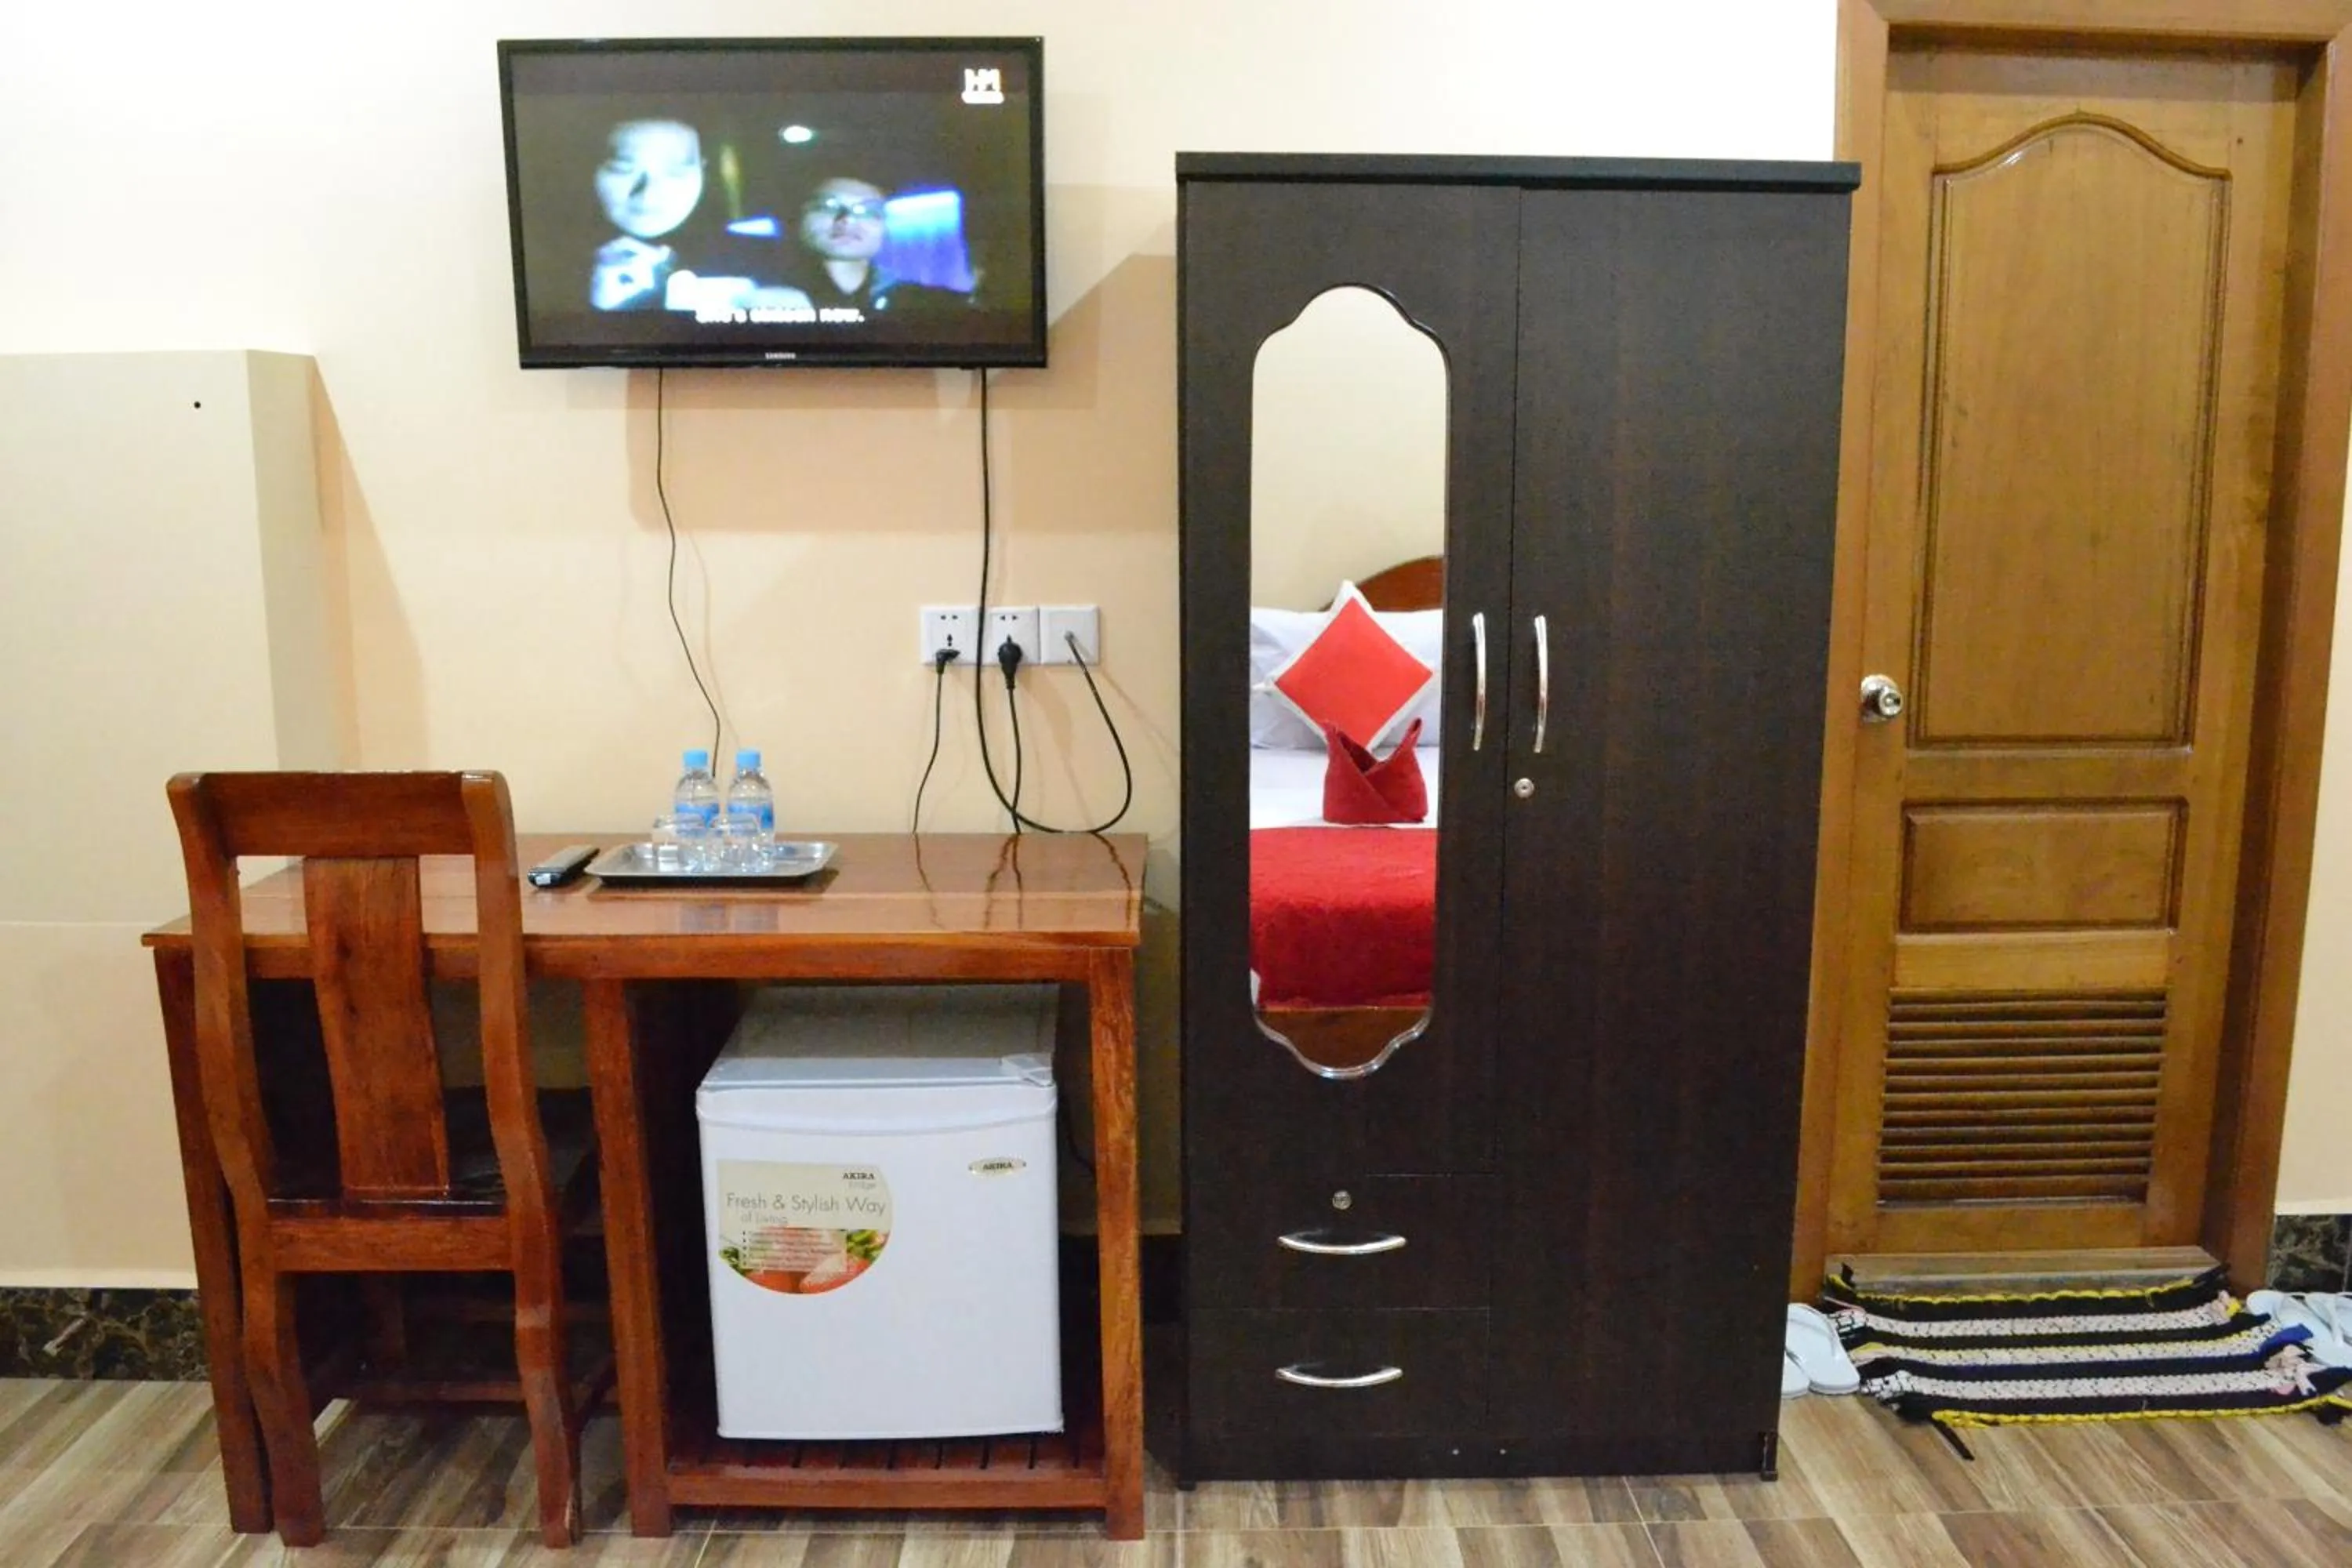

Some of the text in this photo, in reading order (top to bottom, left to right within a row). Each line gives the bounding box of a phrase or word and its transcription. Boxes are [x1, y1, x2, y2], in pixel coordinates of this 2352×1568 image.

[982, 1161, 1014, 1171] AKIRA
[726, 1192, 886, 1215] Fresh & Stylish Way
